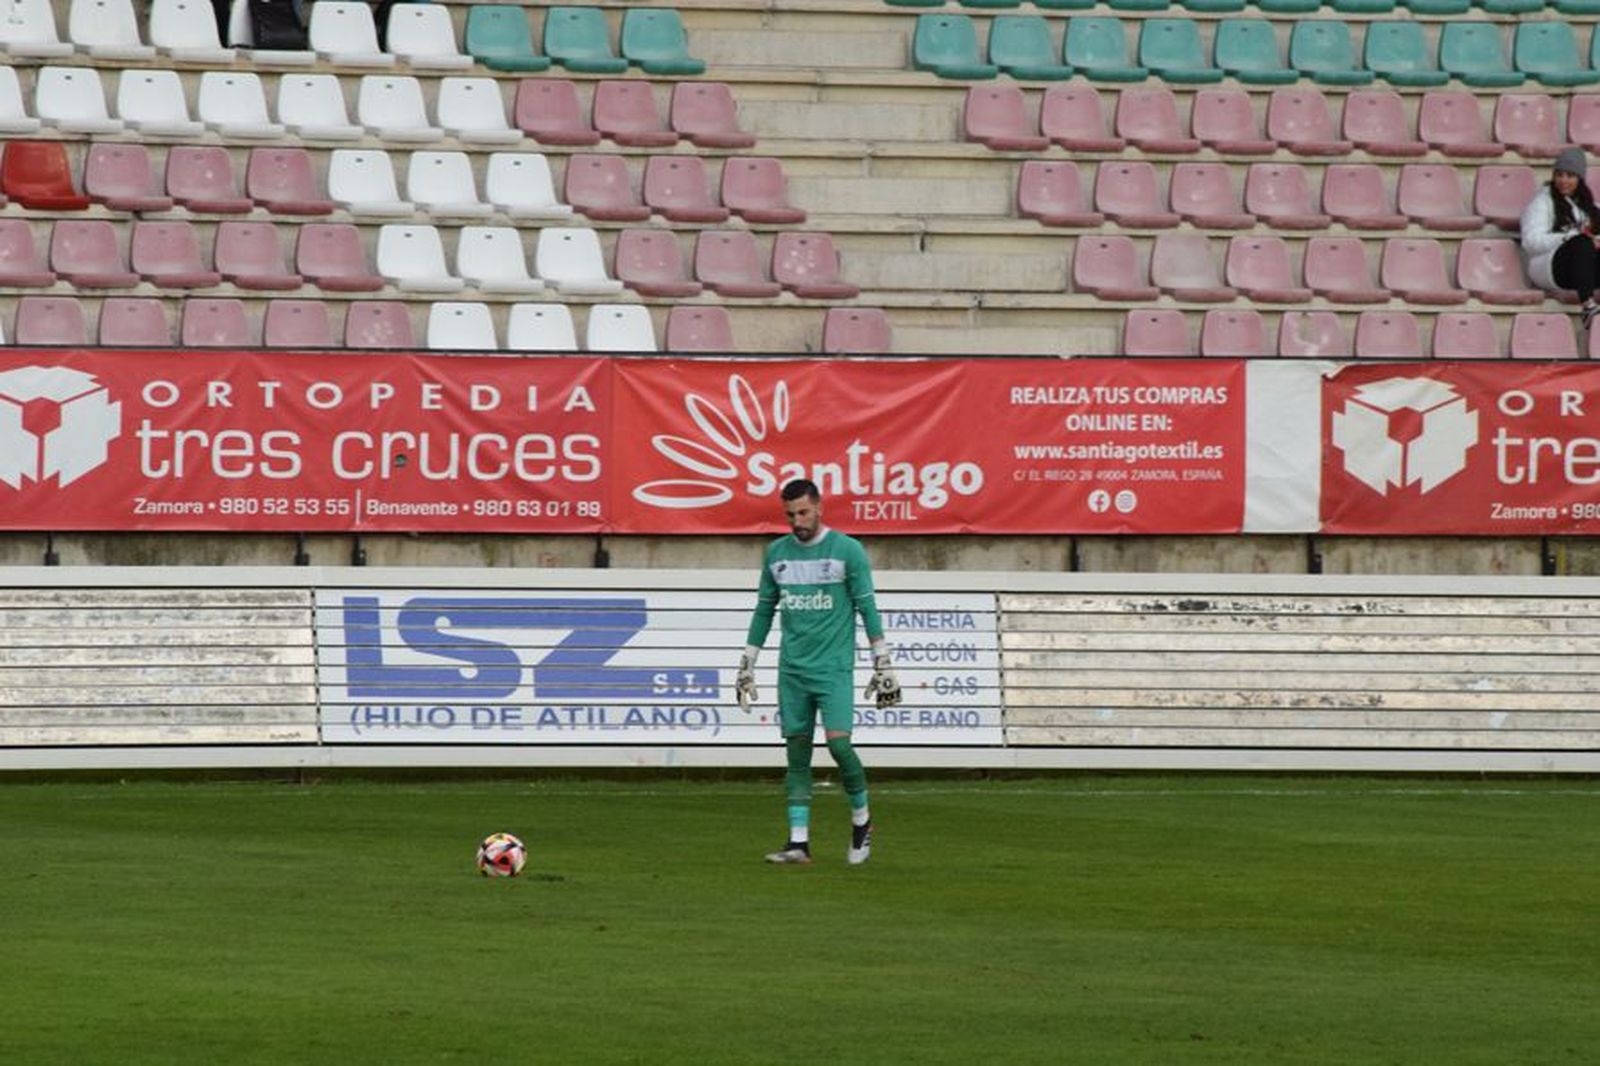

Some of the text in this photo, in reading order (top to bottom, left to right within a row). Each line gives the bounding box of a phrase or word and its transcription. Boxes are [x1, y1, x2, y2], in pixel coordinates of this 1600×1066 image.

[142, 380, 596, 412] ORTOPEDIA
[1011, 386, 1228, 405] REALIZA TUS COMPRAS
[1066, 414, 1173, 432] ONLINE EN:
[136, 419, 601, 482] tres cruces
[1014, 441, 1224, 463] www.santiagotextil.es
[747, 439, 984, 509] Santiago
[133, 498, 601, 517] Zamora 980 52 53 55 Benavente 980 63 01 89
[852, 500, 918, 521] TEXTIL
[1490, 503, 1557, 519] Zamora
[343, 597, 719, 698] LSZ
[652, 673, 714, 695] S.L.
[934, 676, 978, 695] GAS
[350, 706, 721, 736] (HIJO DE ATILANO)
[884, 710, 912, 728] DE
